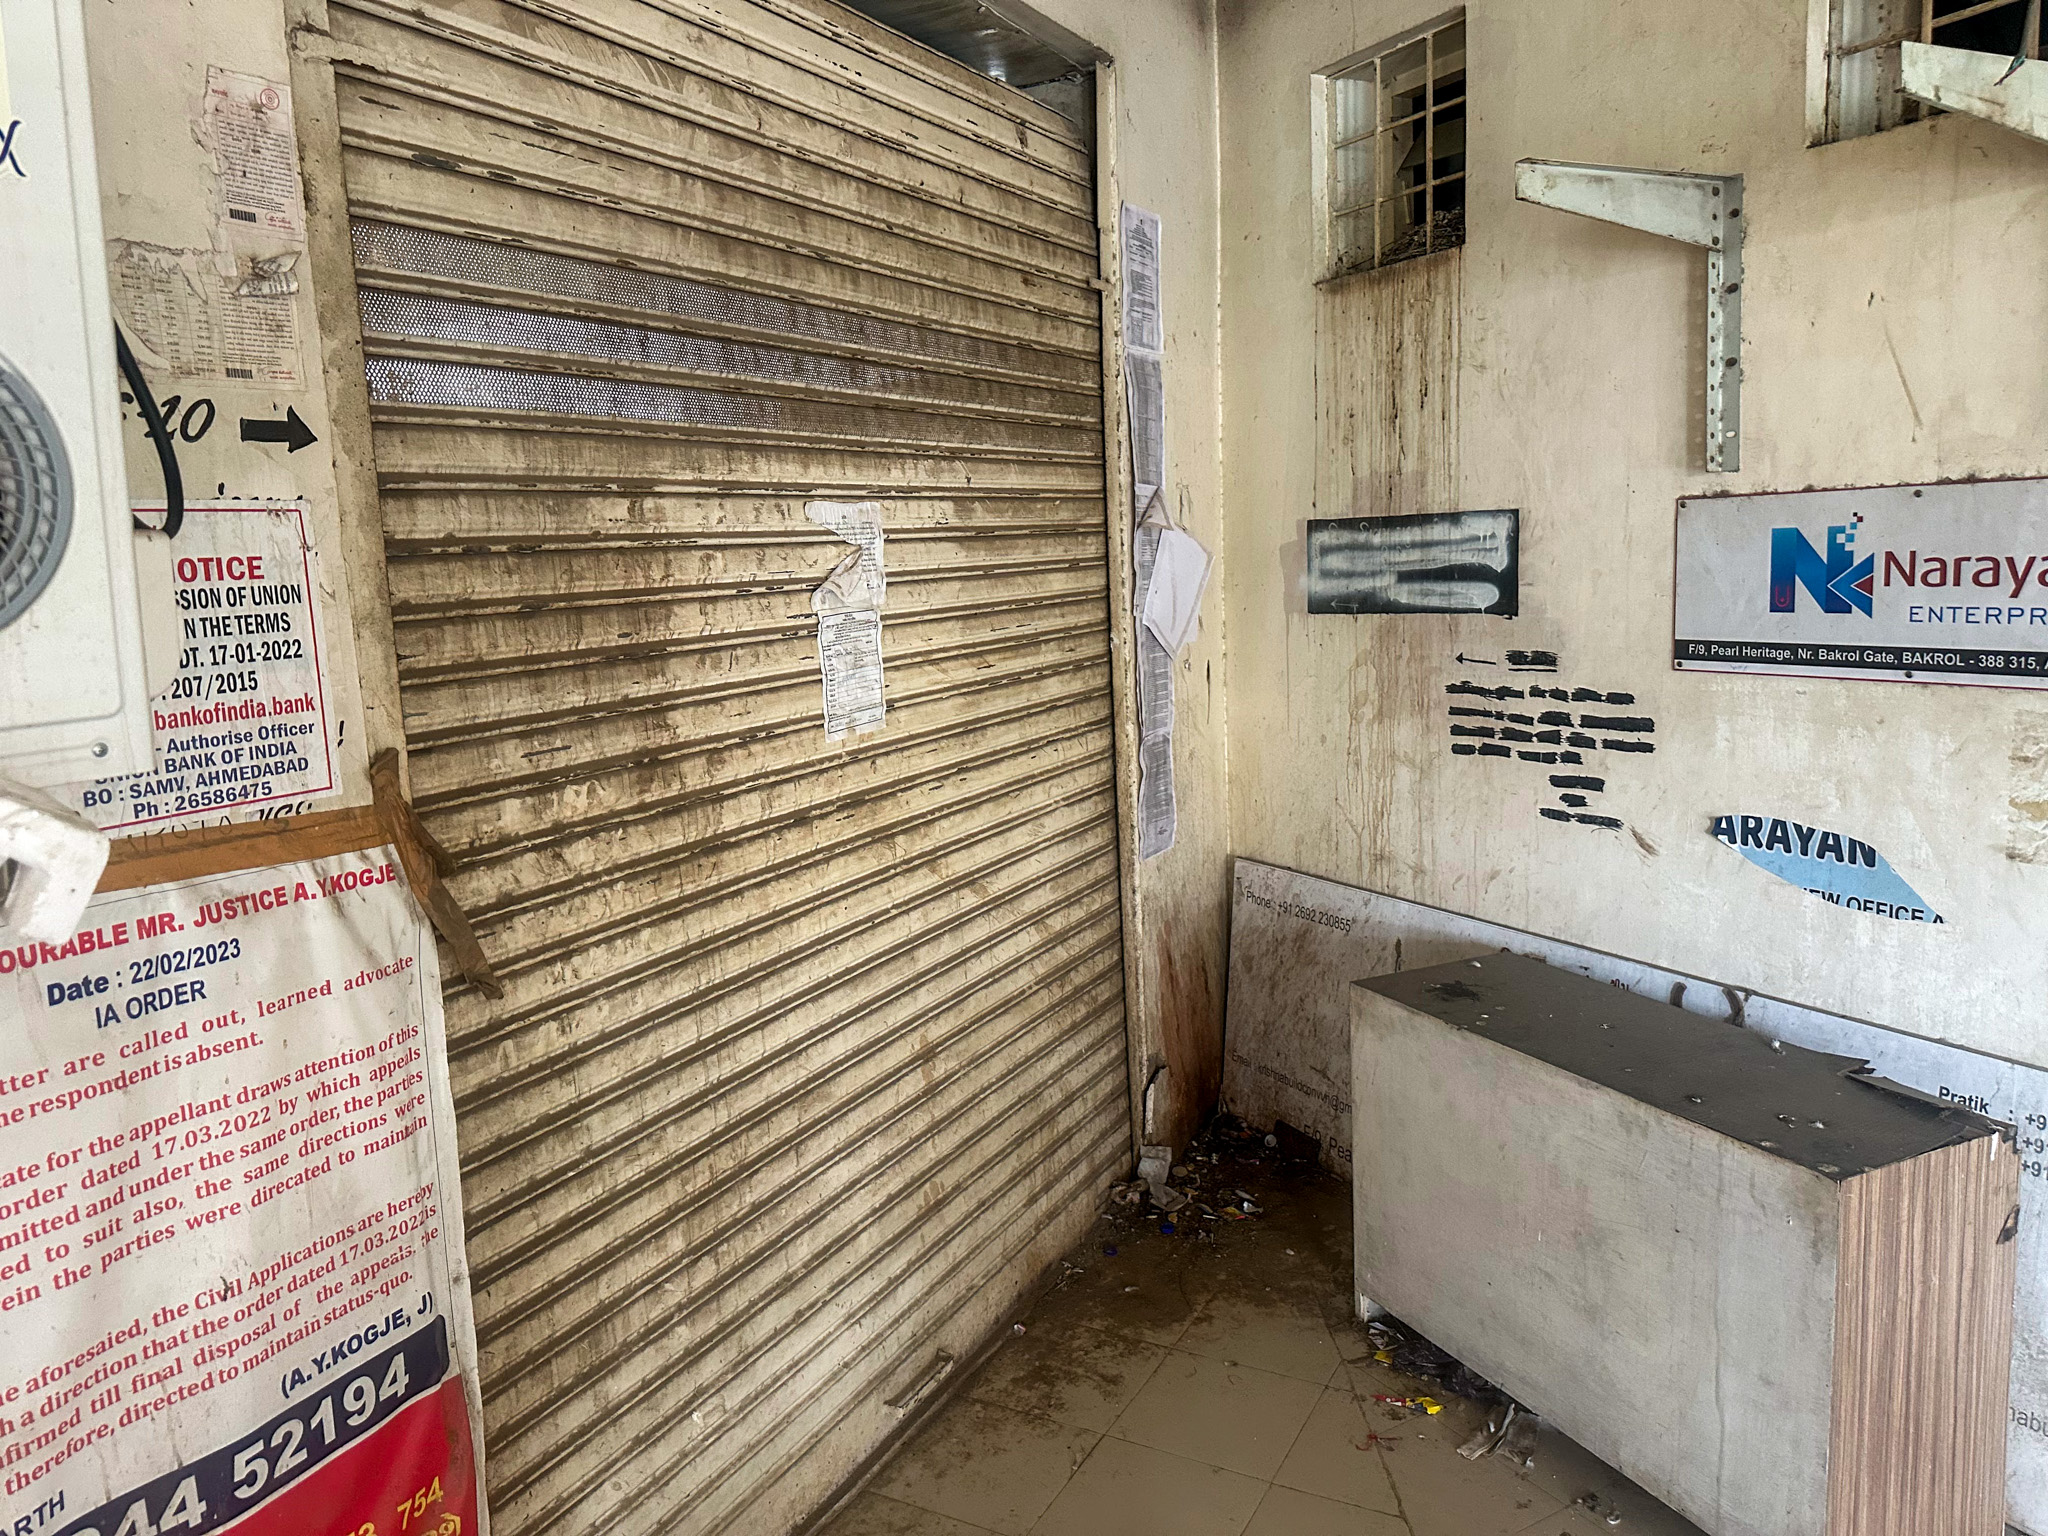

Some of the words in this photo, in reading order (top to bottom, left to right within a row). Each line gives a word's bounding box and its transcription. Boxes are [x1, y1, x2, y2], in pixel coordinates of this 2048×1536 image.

[172, 556, 265, 583] OTICE
[226, 586, 247, 607] OF
[251, 584, 301, 606] UNION
[1909, 606, 2048, 625] ENTERPR
[199, 615, 233, 638] THE
[234, 612, 291, 635] TERMS
[180, 646, 204, 669] DT.
[210, 639, 303, 666] 17-01-2022
[1689, 643, 1708, 657] F/9,
[1711, 645, 1740, 657] Pearl
[1742, 646, 1795, 661] Heritage,
[1798, 648, 1815, 660] Nr.
[1818, 648, 1860, 661] Bakrol
[1864, 650, 1898, 664] Gate,
[1902, 651, 1965, 666] BAKROL
[1978, 655, 2004, 668] 388
[2009, 656, 2040, 671] 315,
[171, 670, 258, 700] 207/2015
[154, 693, 316, 731] bankofindia.bank
[164, 752, 217, 774] BANK
[222, 747, 243, 765] OF
[249, 740, 297, 761] INDIA
[167, 730, 253, 754] Authorise
[258, 721, 315, 746] Officer
[83, 788, 112, 807] BO
[129, 776, 190, 800] SAMV,
[195, 757, 308, 789] AHMEDABAD
[133, 802, 159, 819] Ph
[175, 781, 273, 812] 26586475
[1711, 814, 1877, 868] ARAYAN
[0, 922, 129, 973] OURABLE
[136, 912, 185, 941] MR.
[193, 886, 289, 928] JUSTICE
[1245, 890, 1271, 909] Phone
[1278, 901, 1293, 916] +91
[1295, 905, 1316, 922] 2692
[1319, 911, 1351, 933] 230855
[1846, 896, 1925, 921] OFFICE
[47, 975, 109, 1006] Date
[129, 938, 241, 984] 22/02/2023
[0, 1068, 49, 1096] tter
[64, 1052, 105, 1076] are
[120, 1021, 189, 1059] called
[202, 1009, 246, 1033] out,
[257, 979, 332, 1017] learned
[344, 955, 414, 991] advocate
[95, 1003, 121, 1029] IA
[126, 980, 207, 1019] ORDER
[29, 1060, 162, 1118] respondent
[164, 1053, 182, 1072] is
[186, 1031, 264, 1066] absent.
[0, 1163, 41, 1189] ate
[46, 1147, 83, 1172] for
[88, 1134, 125, 1158] the
[129, 1093, 232, 1142] appellant
[236, 1073, 291, 1105] draws
[295, 1044, 376, 1082] attention
[378, 1032, 395, 1053] of
[396, 1023, 419, 1045] this
[1938, 1085, 1990, 1115] Pratik
[0, 1182, 68, 1220] order
[81, 1150, 141, 1190] dated
[152, 1106, 271, 1160] 17.03.2022
[278, 1096, 299, 1116] by
[306, 1072, 360, 1103] which
[369, 1046, 421, 1083] appeals
[1329, 1136, 1352, 1163] Pea
[2023, 1136, 2048, 1154] +9
[0, 1204, 81, 1252] mitted
[85, 1185, 125, 1218] and
[129, 1161, 194, 1197] under
[200, 1149, 235, 1171] the
[240, 1128, 287, 1158] same
[289, 1106, 341, 1136] order,
[343, 1093, 373, 1114] the
[377, 1069, 424, 1107] parties
[0, 1253, 31, 1281] ed
[44, 1243, 70, 1263] to
[83, 1217, 123, 1248] suit
[132, 1196, 184, 1224] also,
[195, 1178, 232, 1200] the
[243, 1152, 290, 1184] same
[298, 1112, 388, 1158] directions
[394, 1092, 425, 1119] were
[1, 1284, 42, 1311] ein
[52, 1264, 92, 1290] the
[101, 1224, 176, 1275] parties
[185, 1201, 241, 1230] were
[250, 1156, 332, 1208] direcated
[338, 1149, 355, 1166] to
[363, 1115, 428, 1156] maintain
[0, 1386, 20, 1407] e
[26, 1318, 148, 1394] aforesaied,
[152, 1302, 190, 1328] the
[194, 1278, 243, 1308] Civil
[247, 1223, 356, 1290] Applications
[357, 1210, 384, 1233] are
[386, 1181, 435, 1219] hereby
[417, 1291, 433, 1316] J)
[20, 1410, 35, 1427] a
[40, 1353, 138, 1417] direction
[142, 1329, 190, 1360] that
[193, 1315, 229, 1340] the
[233, 1285, 283, 1323] order
[286, 1259, 336, 1293] dated
[90, 1384, 122, 1415] till
[131, 1356, 183, 1394] final
[193, 1312, 277, 1367] disposal
[283, 1299, 301, 1322] of
[316, 1278, 343, 1304] the
[4, 1422, 115, 1495] therefore,
[118, 1372, 215, 1428] directed
[218, 1365, 239, 1385] to
[243, 1317, 322, 1372] maintain
[324, 1271, 412, 1325] status-quo.
[233, 1351, 410, 1500] 52194
[397, 1475, 444, 1530] 754
